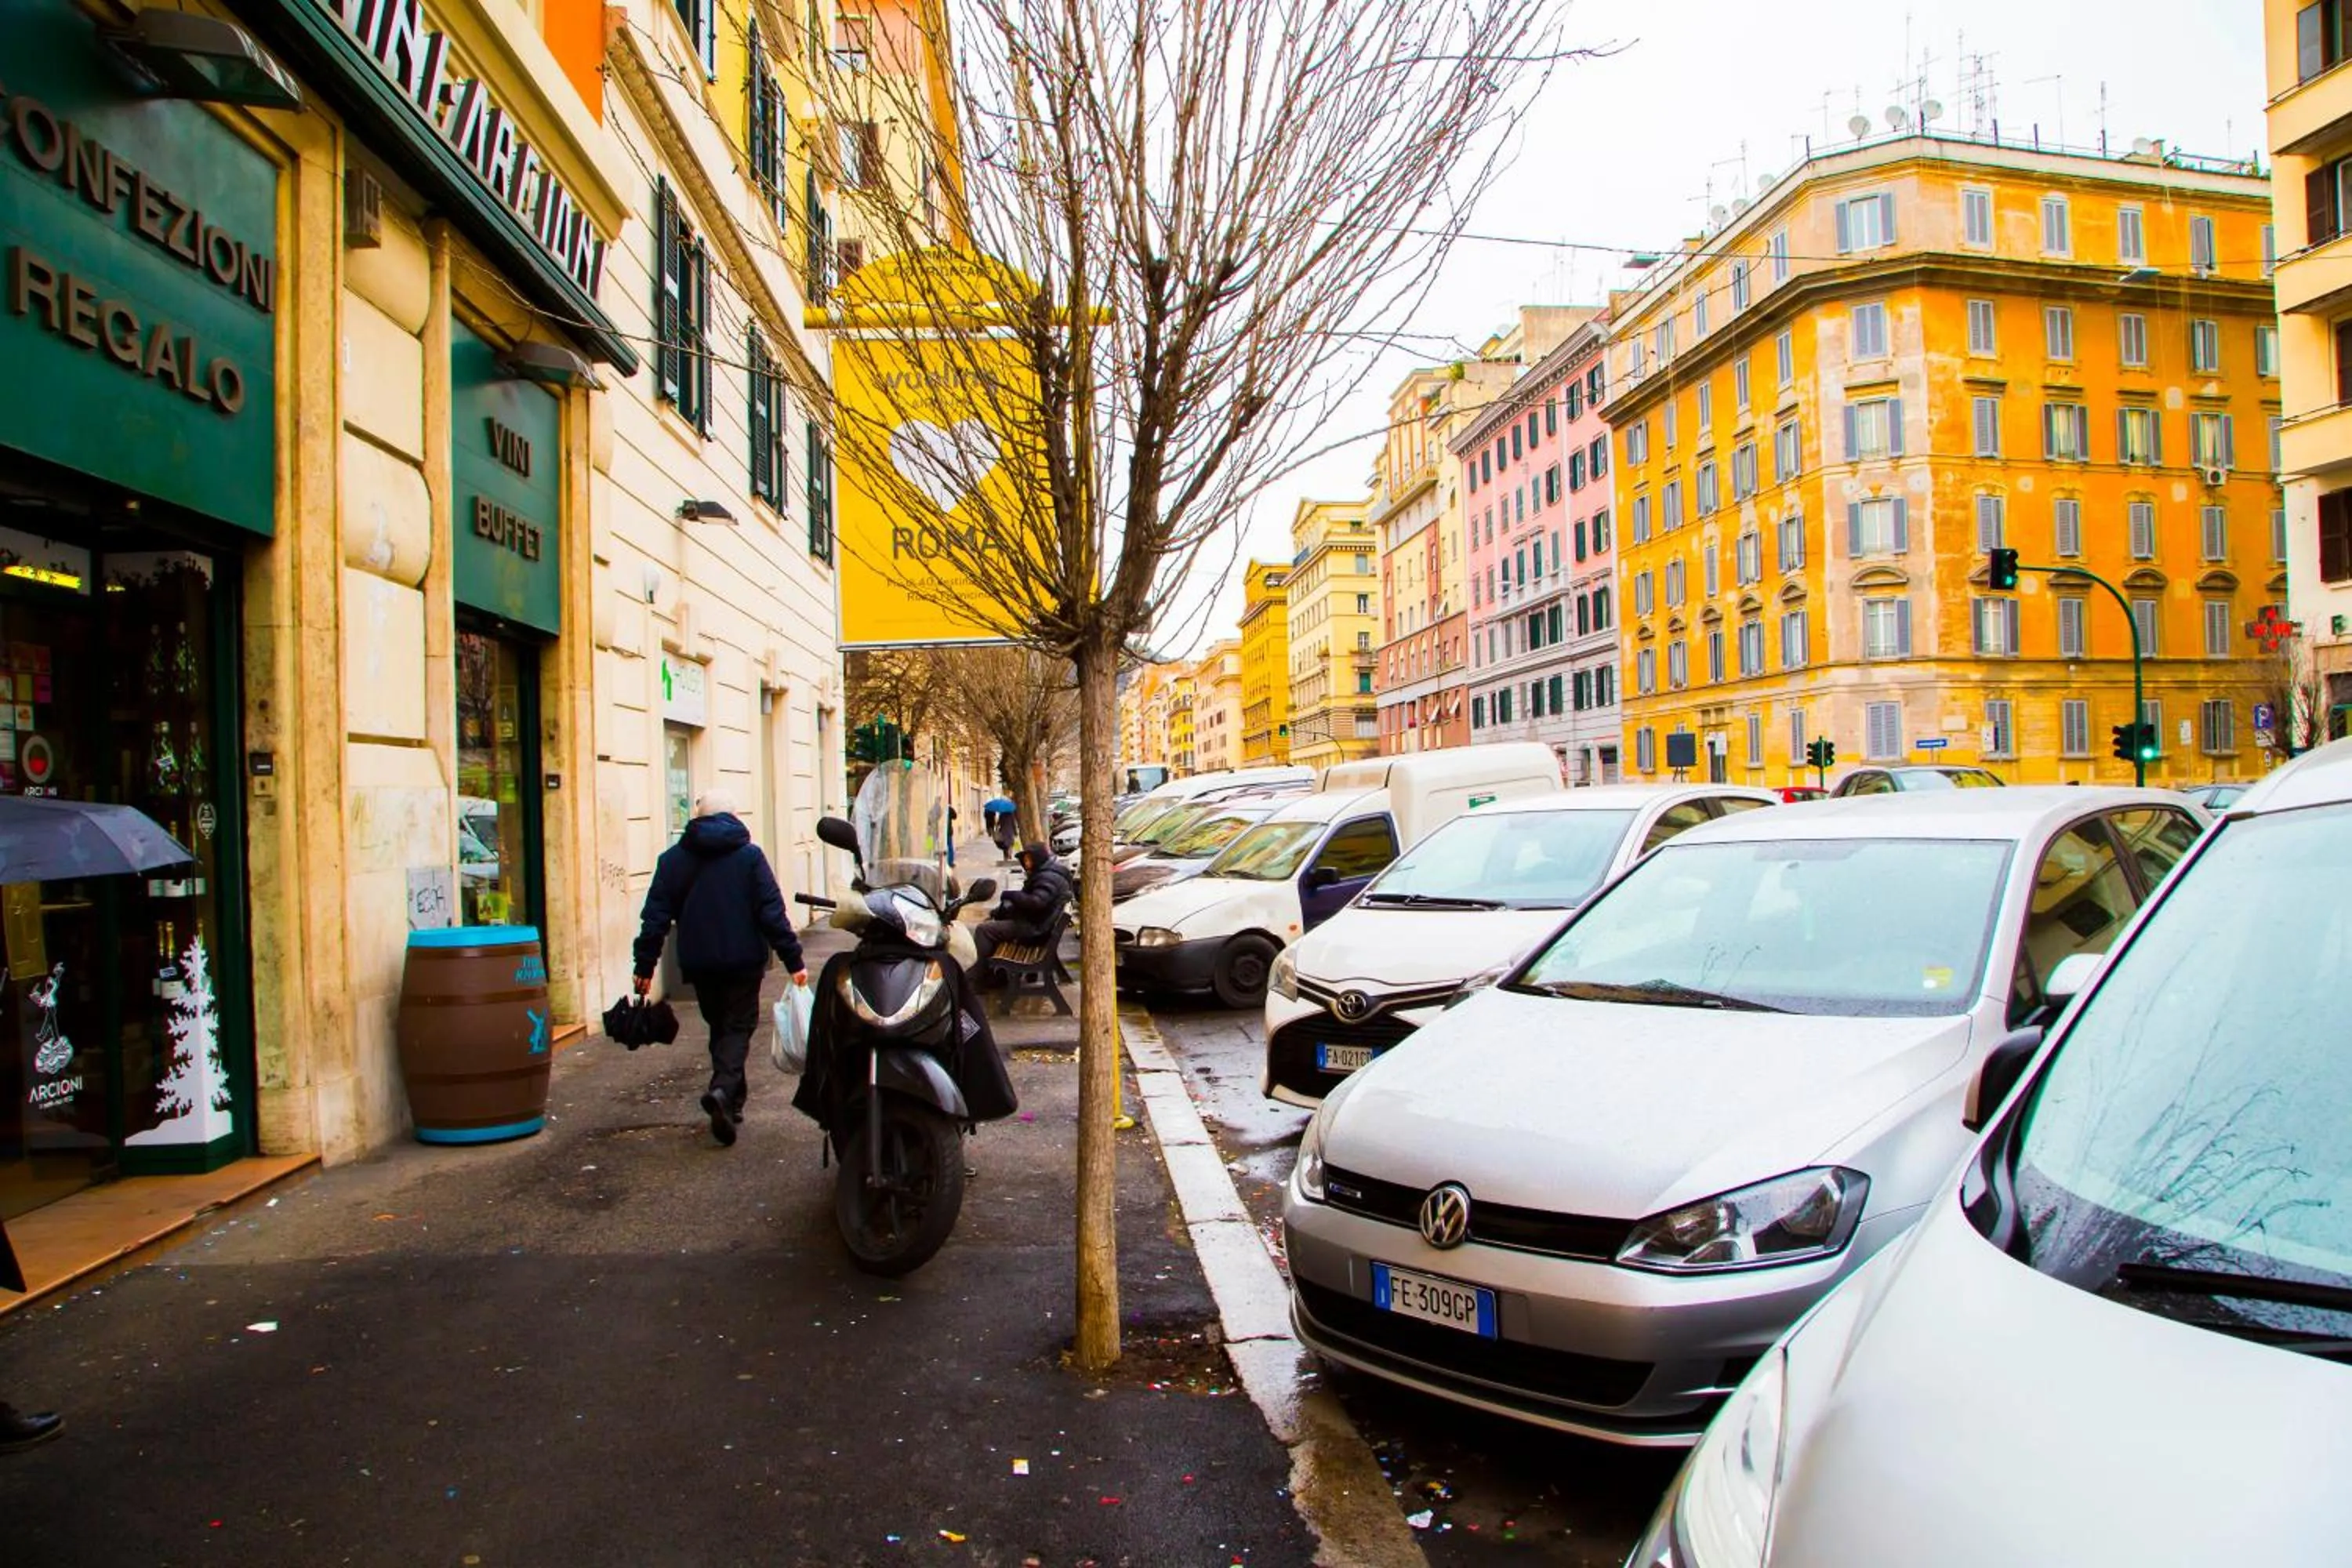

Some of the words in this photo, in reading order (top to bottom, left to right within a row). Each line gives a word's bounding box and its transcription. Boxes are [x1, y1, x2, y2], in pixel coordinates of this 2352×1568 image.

[0, 82, 274, 313] ONFEZIONI
[10, 245, 245, 414] REGALO
[484, 416, 531, 477] VINI
[470, 495, 542, 562] BUFFET
[29, 1075, 83, 1103] ARCIONI
[1391, 1276, 1412, 1307] FE
[1417, 1283, 1475, 1323] 309GP
